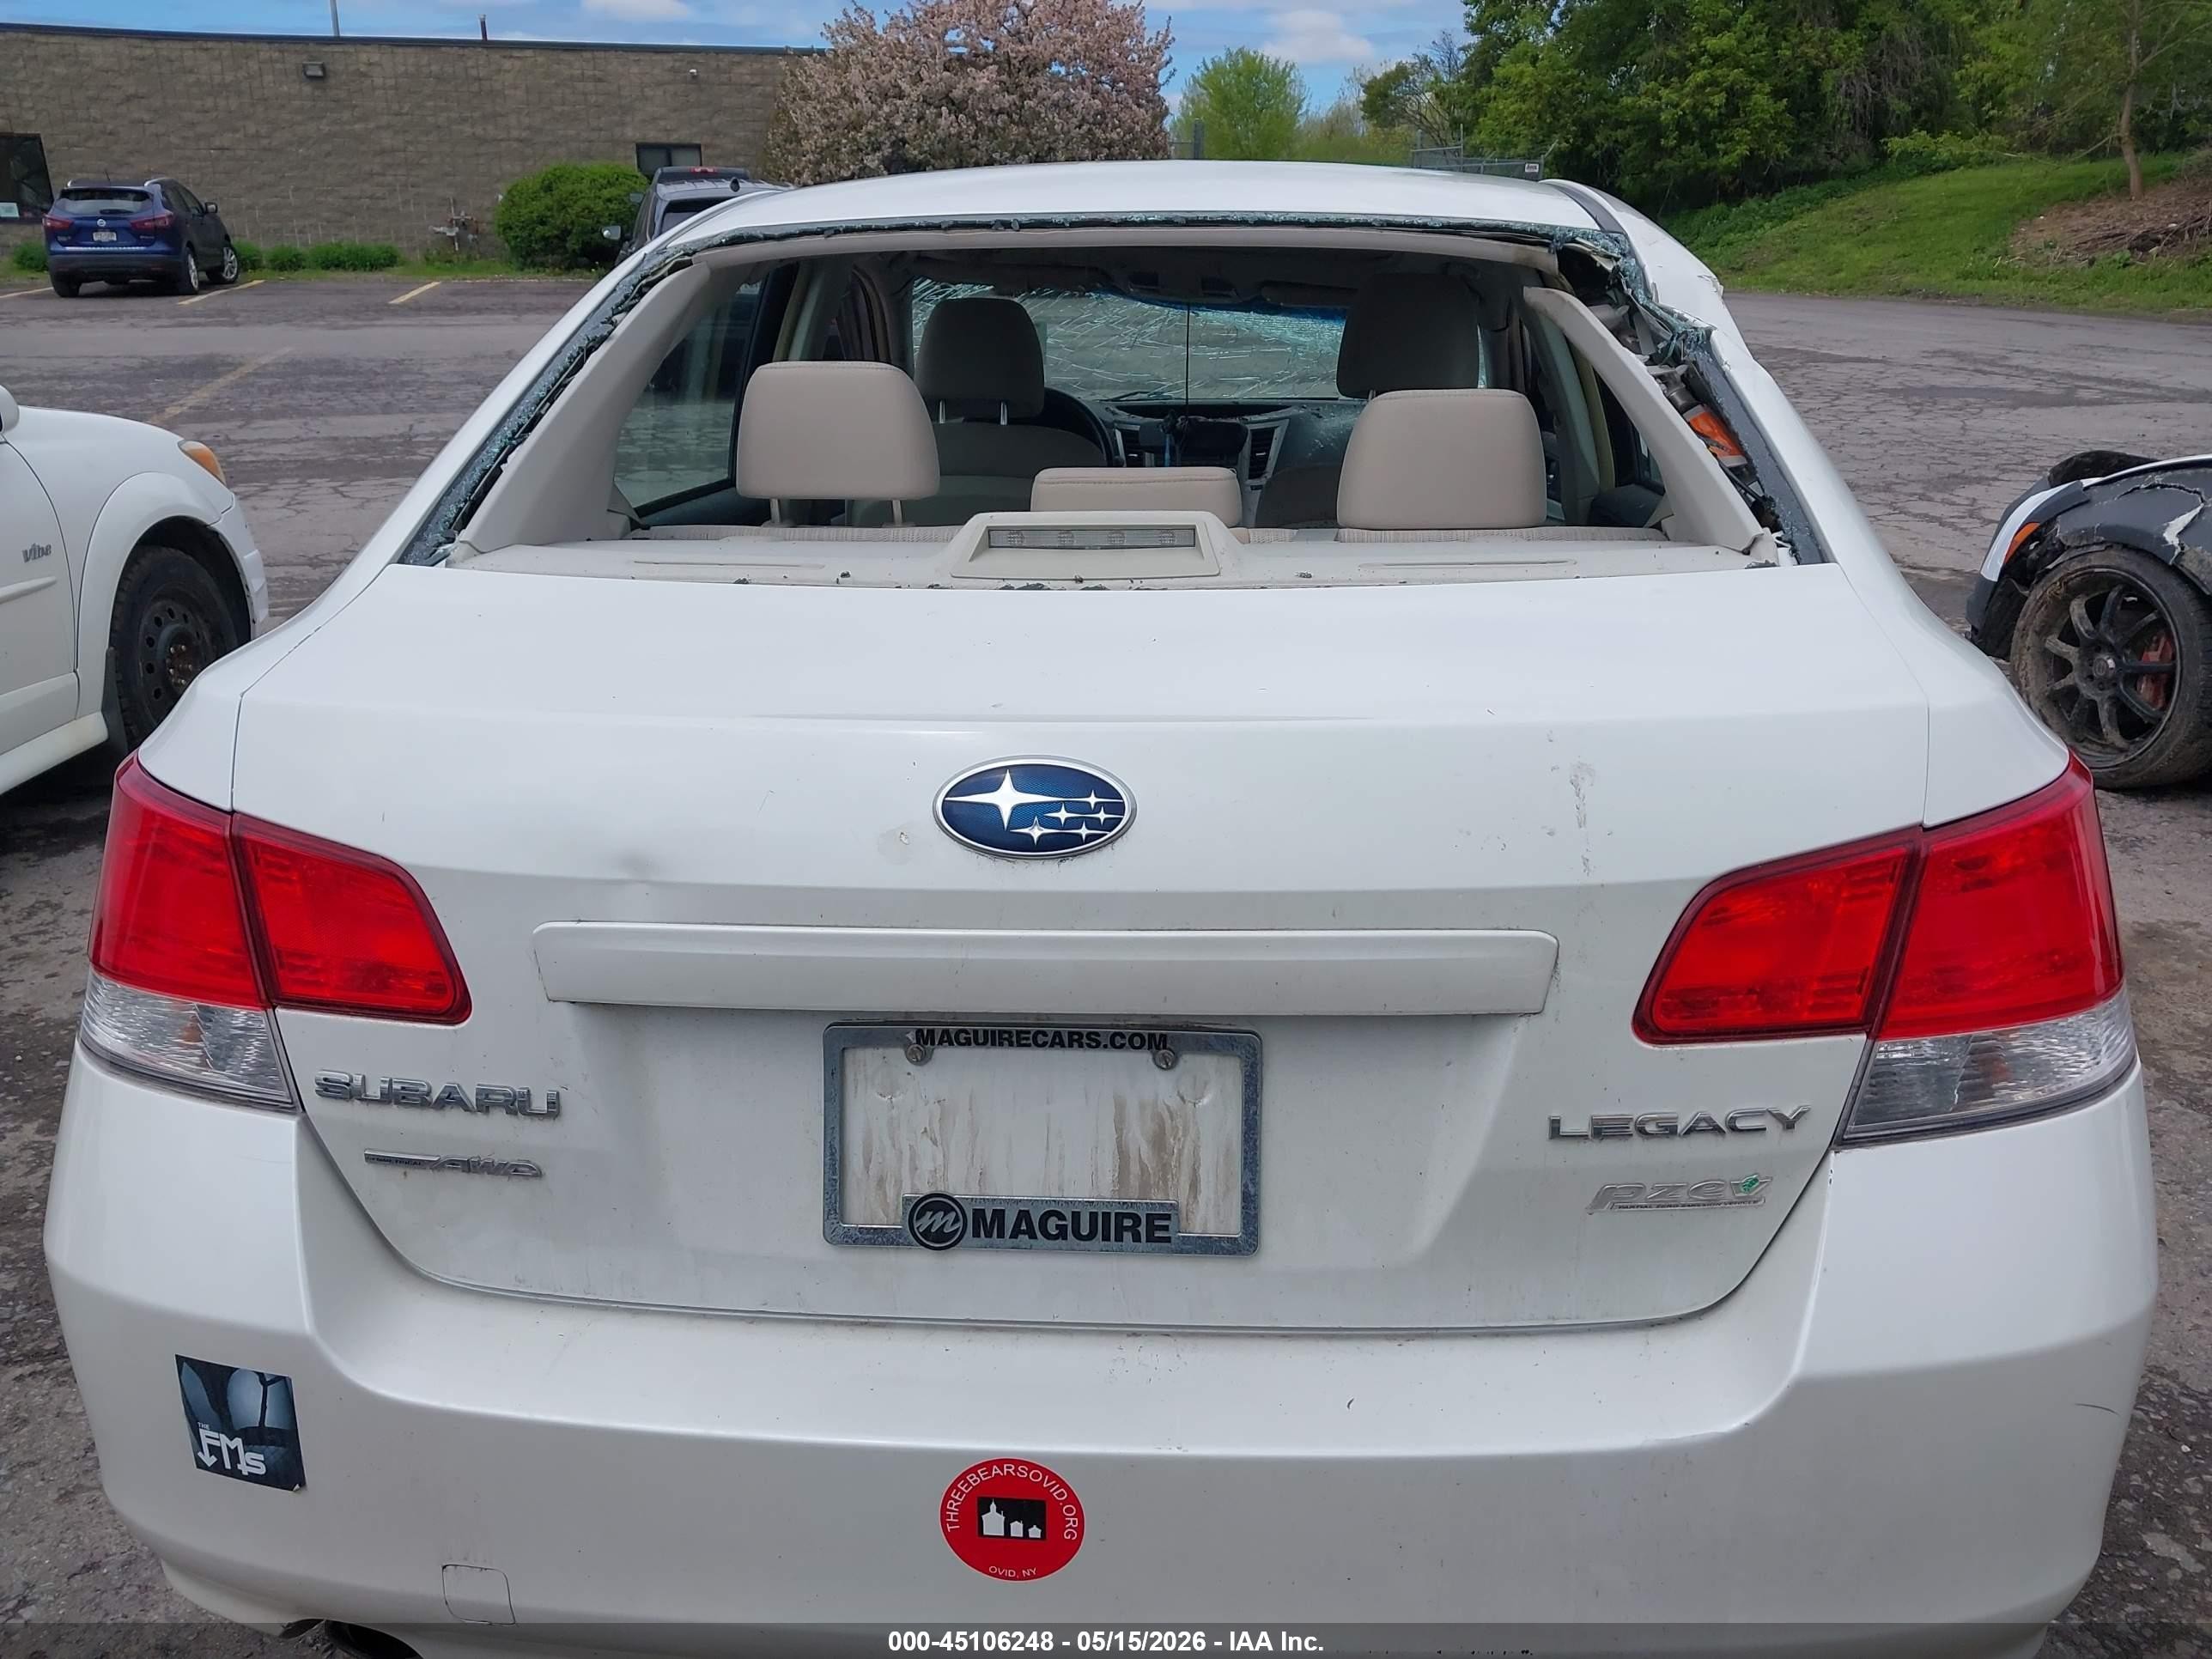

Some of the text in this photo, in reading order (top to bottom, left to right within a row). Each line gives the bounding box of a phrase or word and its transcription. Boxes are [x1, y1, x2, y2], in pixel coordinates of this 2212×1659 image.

[915, 1029, 1168, 1050] MAGUIRECARS.COM
[314, 1070, 561, 1118] SUBARU
[1549, 1105, 1811, 1139] LEGACY
[431, 1156, 543, 1177] AWD
[971, 1208, 1172, 1243] MAGUIRE
[198, 1422, 210, 1431] THE
[945, 1463, 1079, 1540] THREEBEARSOVID.ORG
[1022, 1567, 1037, 1577] NY
